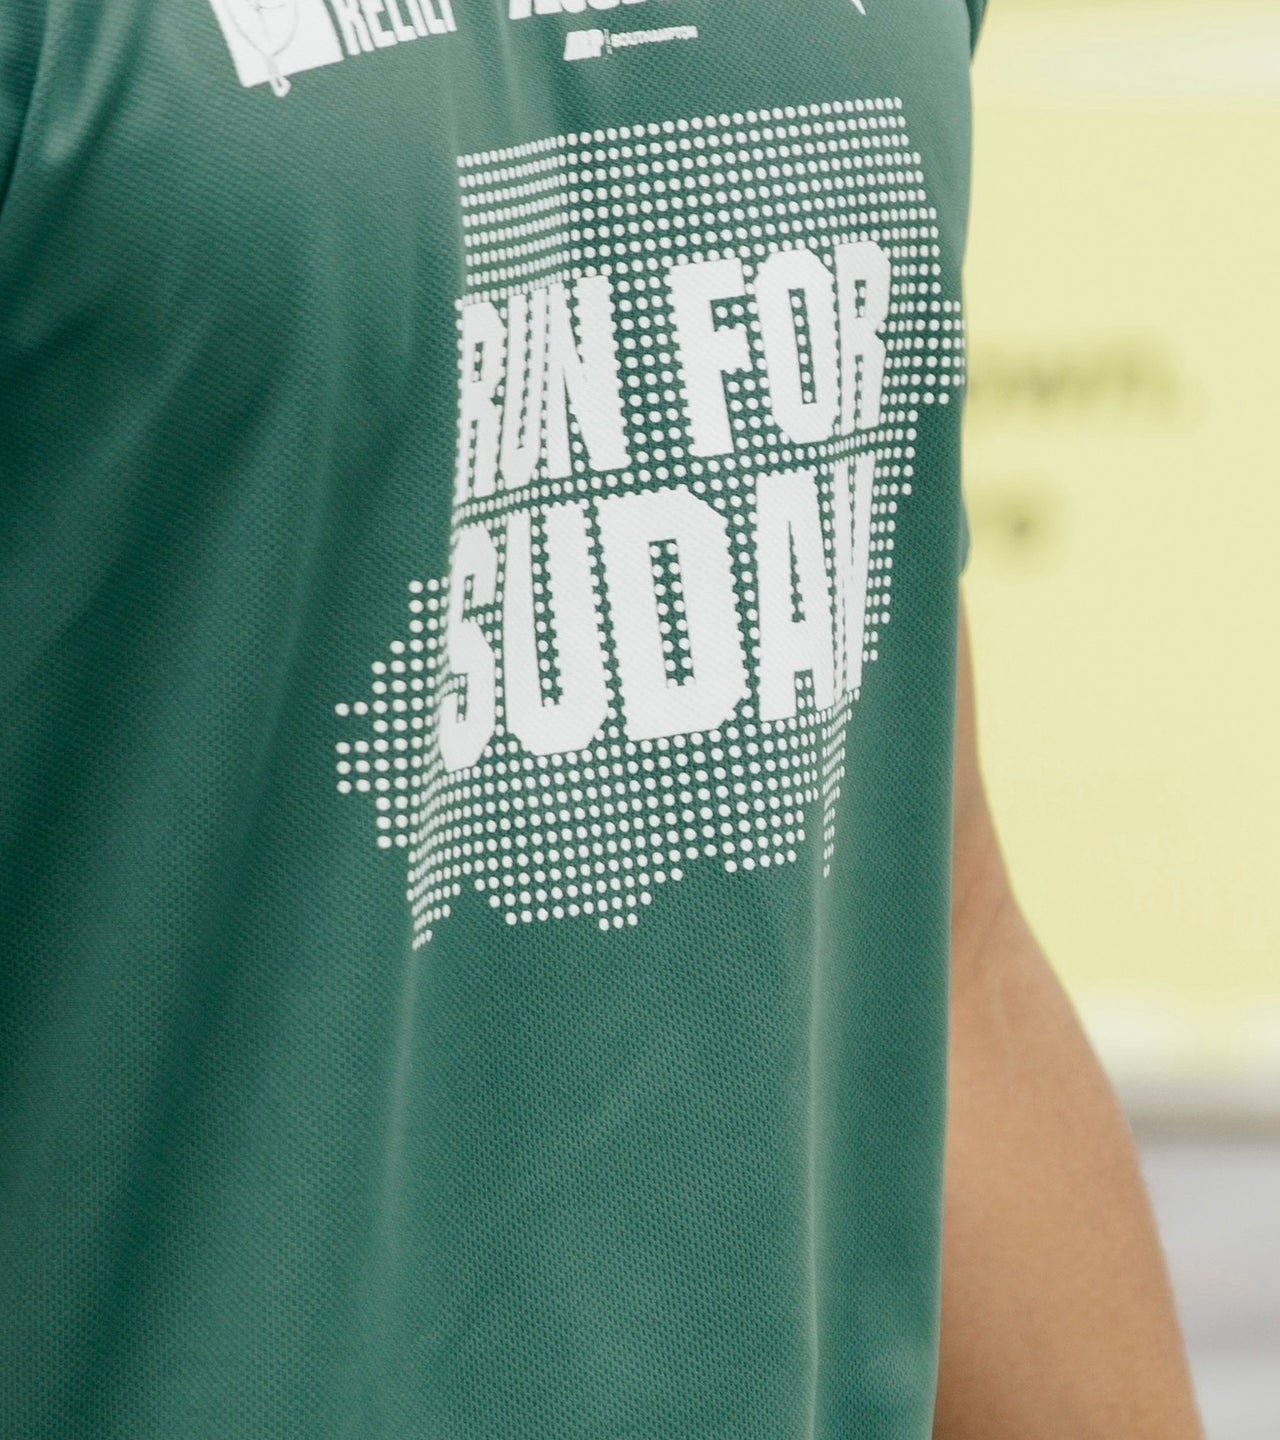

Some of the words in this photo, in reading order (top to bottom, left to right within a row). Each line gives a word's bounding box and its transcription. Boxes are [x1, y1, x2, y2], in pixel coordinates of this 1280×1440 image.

[453, 273, 631, 507] RUN
[668, 239, 891, 457] FOR
[437, 451, 876, 772] SUDAN
